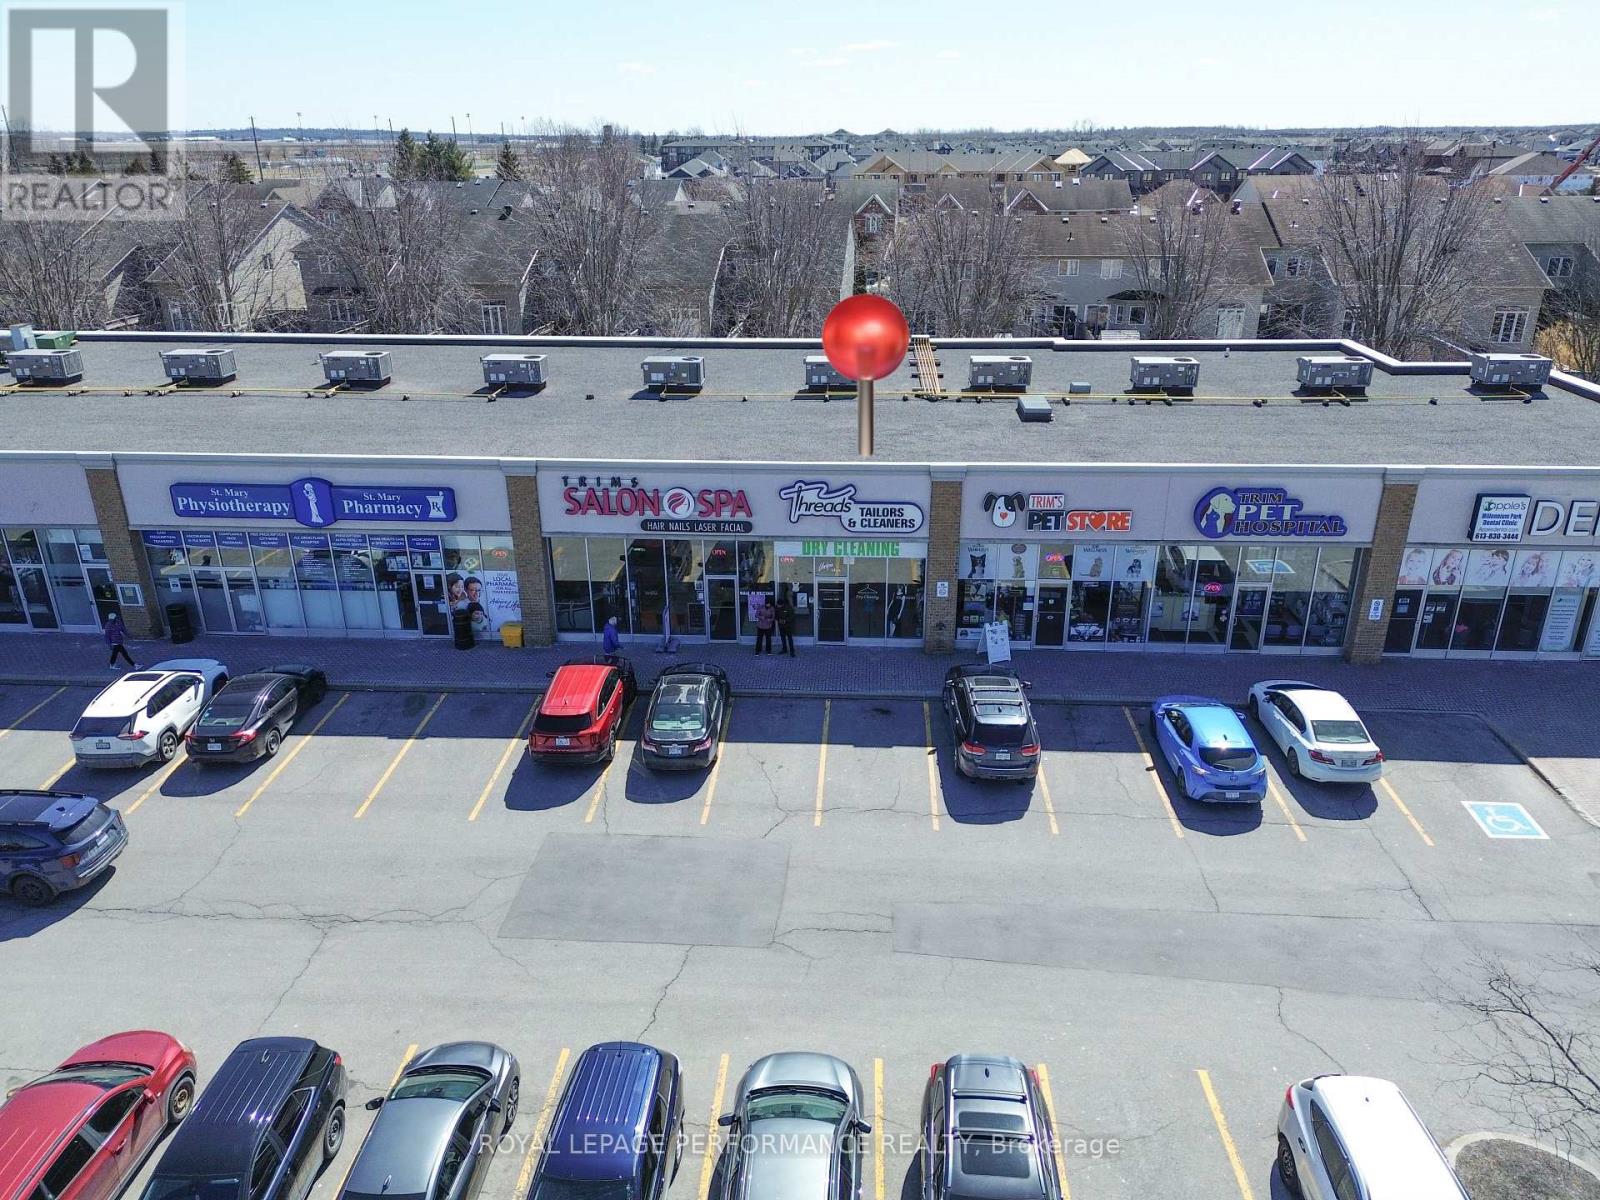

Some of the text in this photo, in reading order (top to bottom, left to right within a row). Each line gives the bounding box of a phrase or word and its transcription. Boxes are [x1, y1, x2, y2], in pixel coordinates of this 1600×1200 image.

[562, 476, 639, 488] TRIMS
[210, 488, 249, 499] St. Mary
[363, 492, 401, 503] St. Mary
[1238, 492, 1283, 504] TRIM
[177, 497, 292, 516] Physiotherapy
[563, 487, 752, 518] SALON SPA
[782, 486, 854, 520] Threads
[1032, 495, 1064, 508] TRIM'S
[342, 500, 423, 518] Pharmacy
[859, 507, 904, 518] TAILORS
[1237, 505, 1298, 520] PET
[647, 521, 745, 533] HAIR NAILS LASER FACIAL
[848, 519, 915, 529] & CLEANERS
[1028, 512, 1065, 531] PET
[1233, 520, 1344, 534] HOSPITAL
[802, 541, 899, 556] DRY CLEANING
